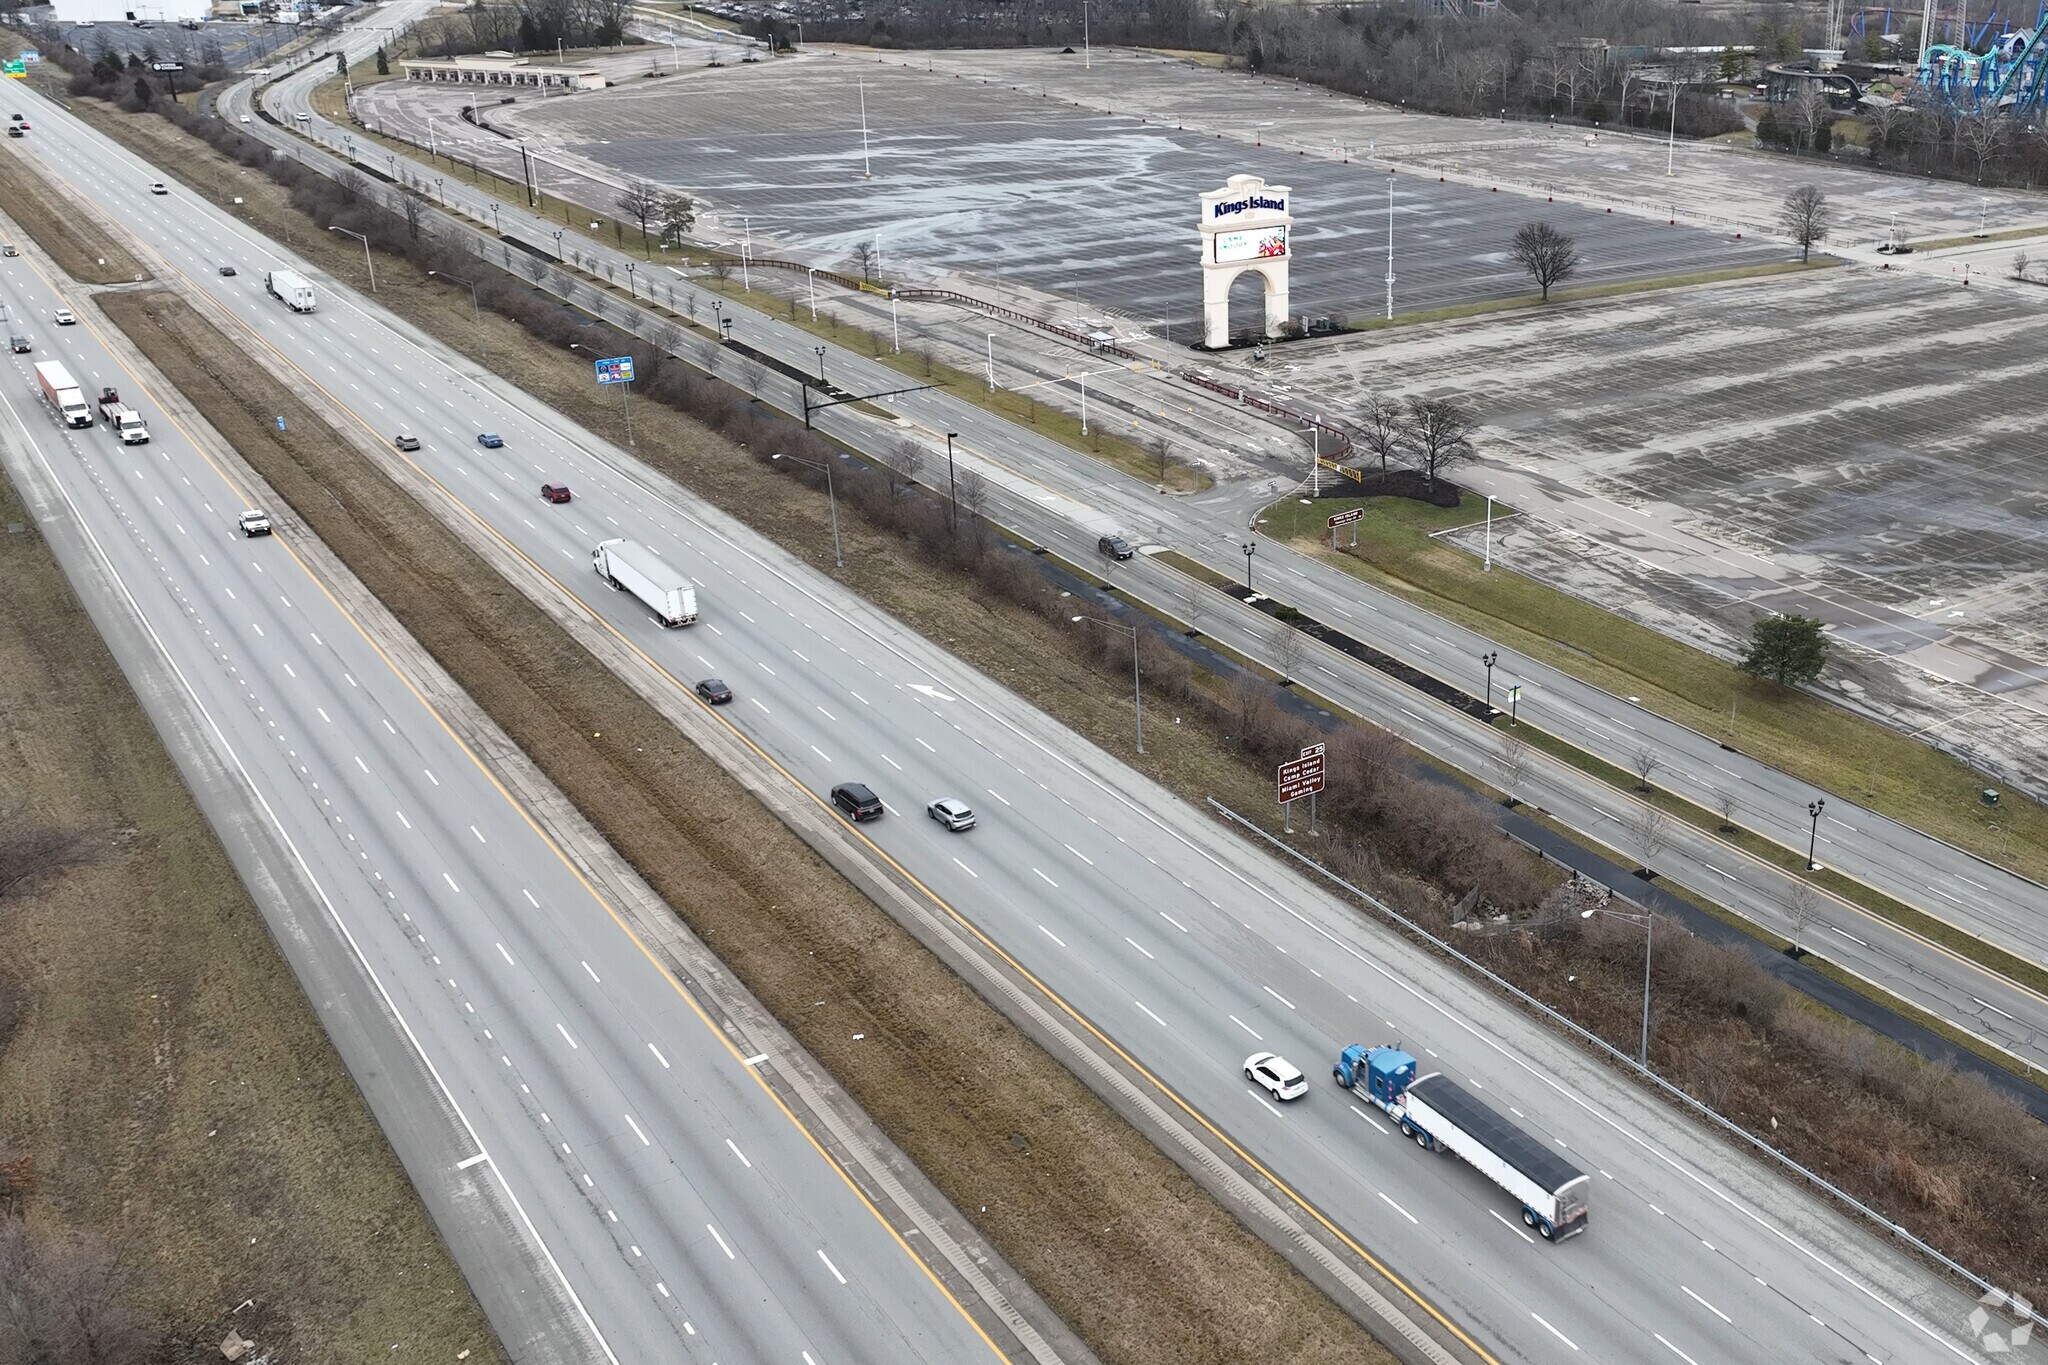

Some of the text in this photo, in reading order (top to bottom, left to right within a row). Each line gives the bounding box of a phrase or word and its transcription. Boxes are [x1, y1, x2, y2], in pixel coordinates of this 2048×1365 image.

[1215, 196, 1284, 218] Kings Island
[1283, 758, 1320, 775] Kings Island
[1284, 767, 1319, 781] Camp Cedar
[1282, 777, 1320, 793] Miami Valley
[1291, 786, 1312, 797] Gaming
